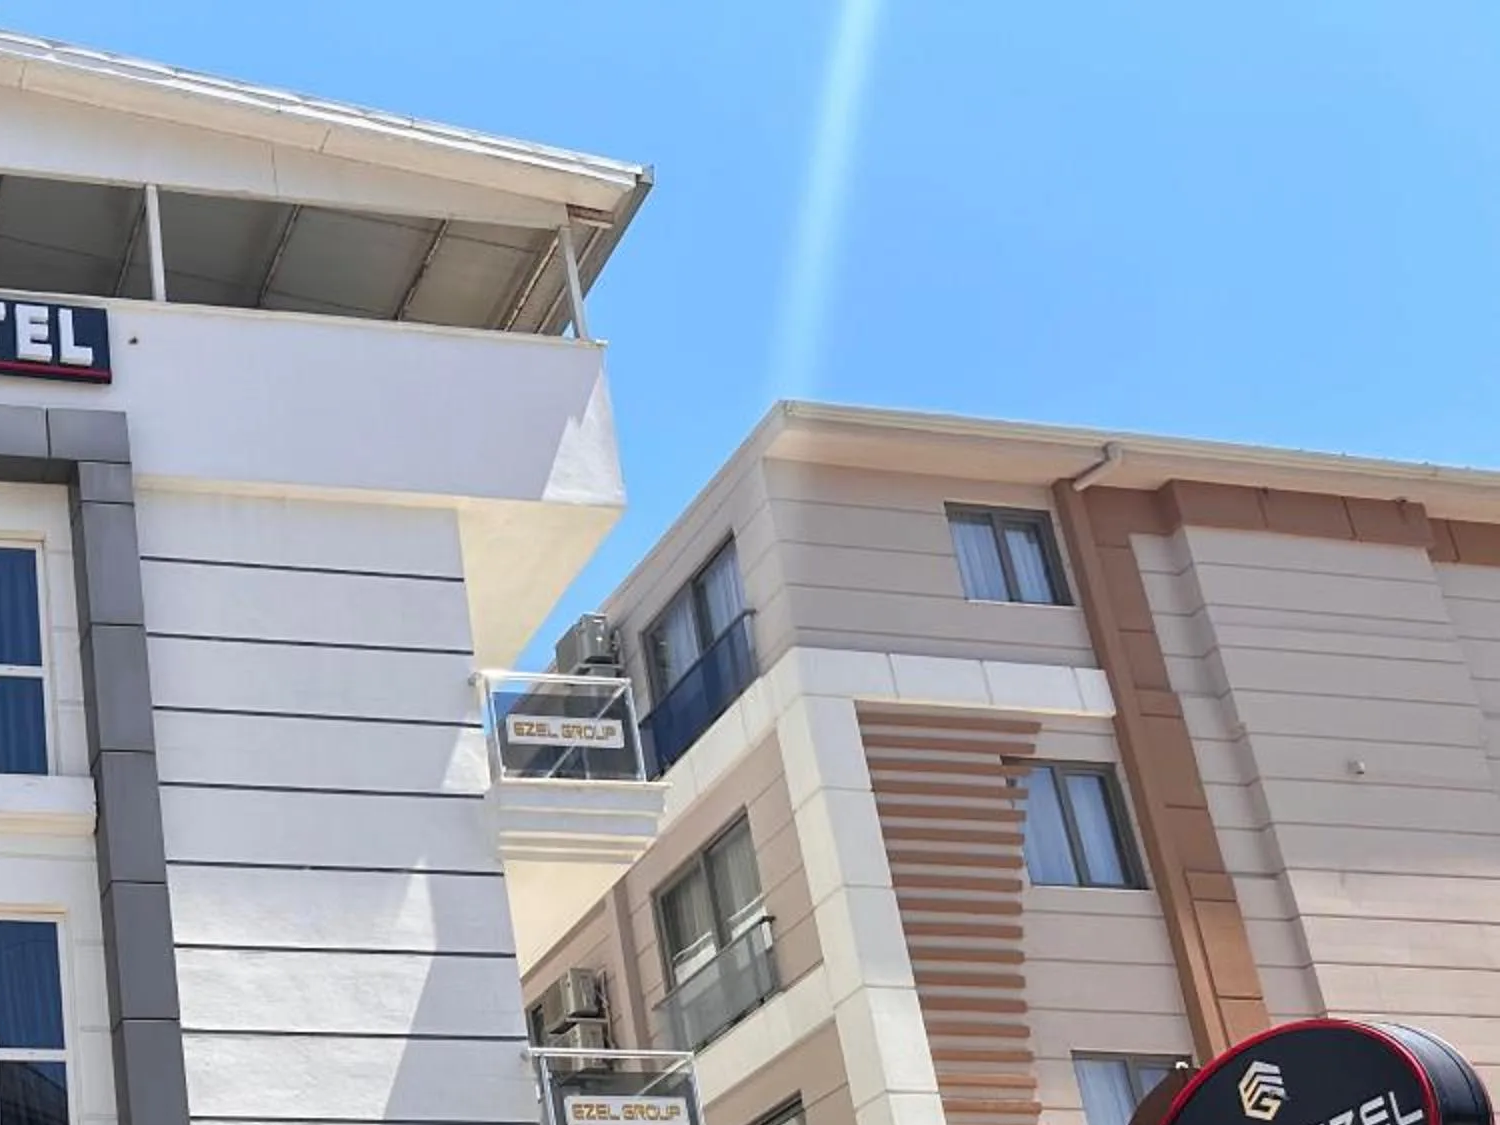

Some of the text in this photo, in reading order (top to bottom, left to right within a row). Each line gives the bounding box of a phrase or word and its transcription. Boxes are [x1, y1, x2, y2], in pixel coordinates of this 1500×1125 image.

[513, 721, 617, 740] EZEL GROUP
[571, 1103, 681, 1121] EZEL GROUP
